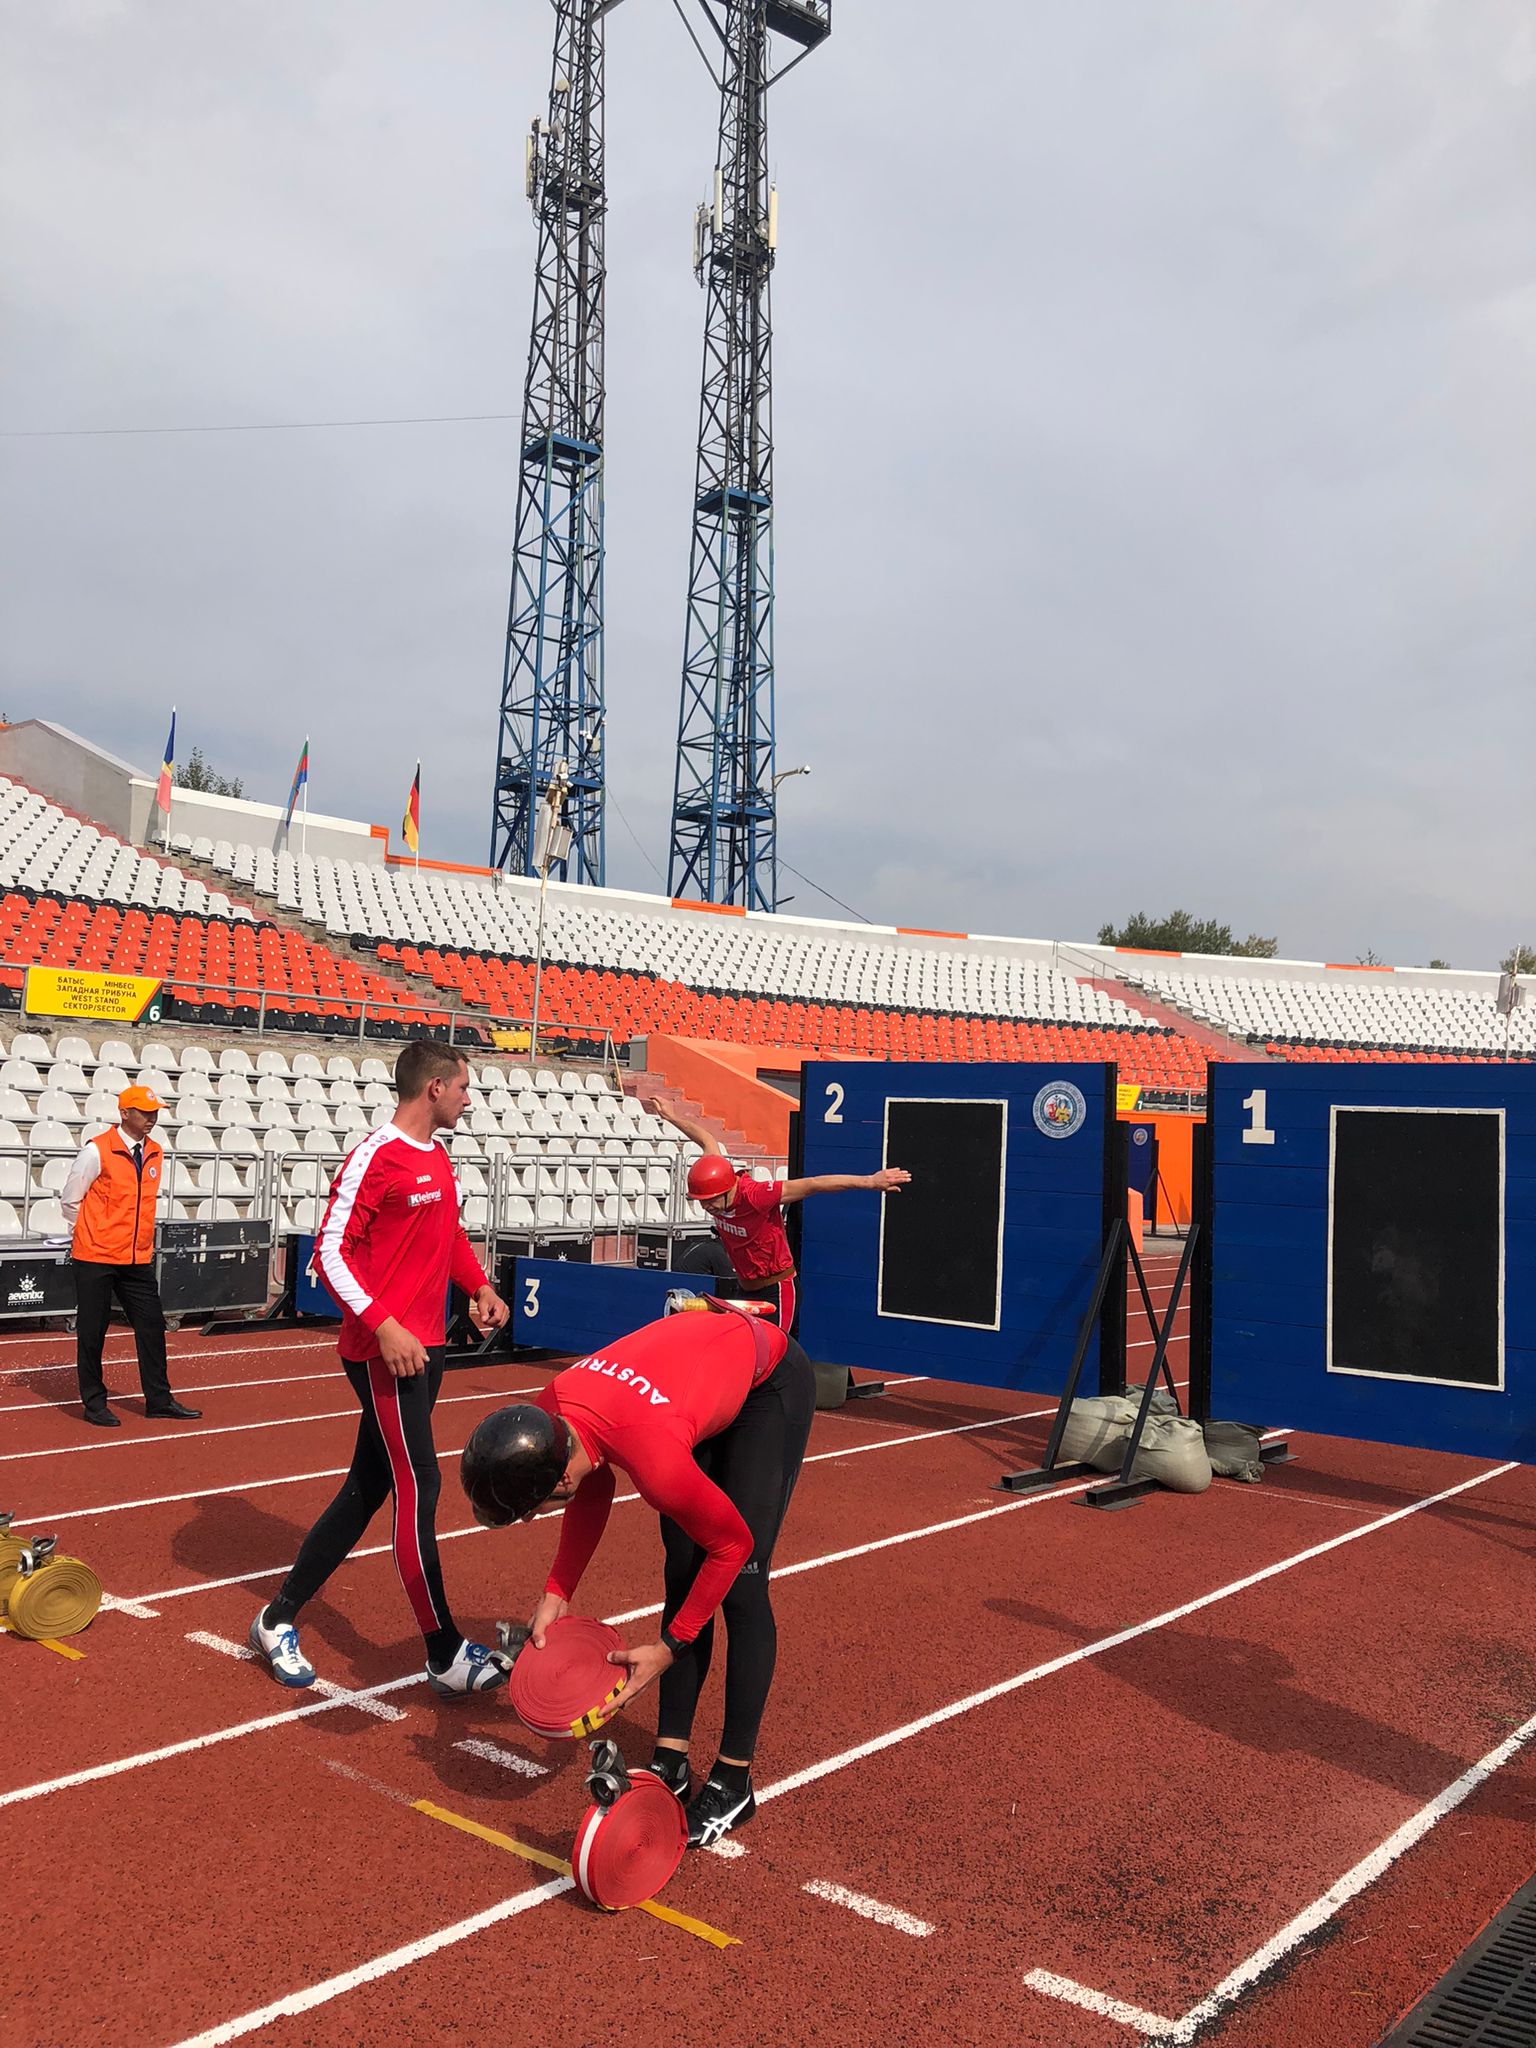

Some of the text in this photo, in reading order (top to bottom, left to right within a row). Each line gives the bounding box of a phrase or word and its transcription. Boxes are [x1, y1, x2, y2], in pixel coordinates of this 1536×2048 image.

[58, 976, 135, 990] БАТЫС МІНБЕСІ
[56, 985, 137, 998] ЗАПАДНАЯ ТРИБУНА
[71, 994, 92, 1002] WEST
[149, 1005, 161, 1021] 6
[824, 1082, 845, 1124] 2
[1242, 1089, 1276, 1145] 1
[523, 1277, 541, 1318] 3
